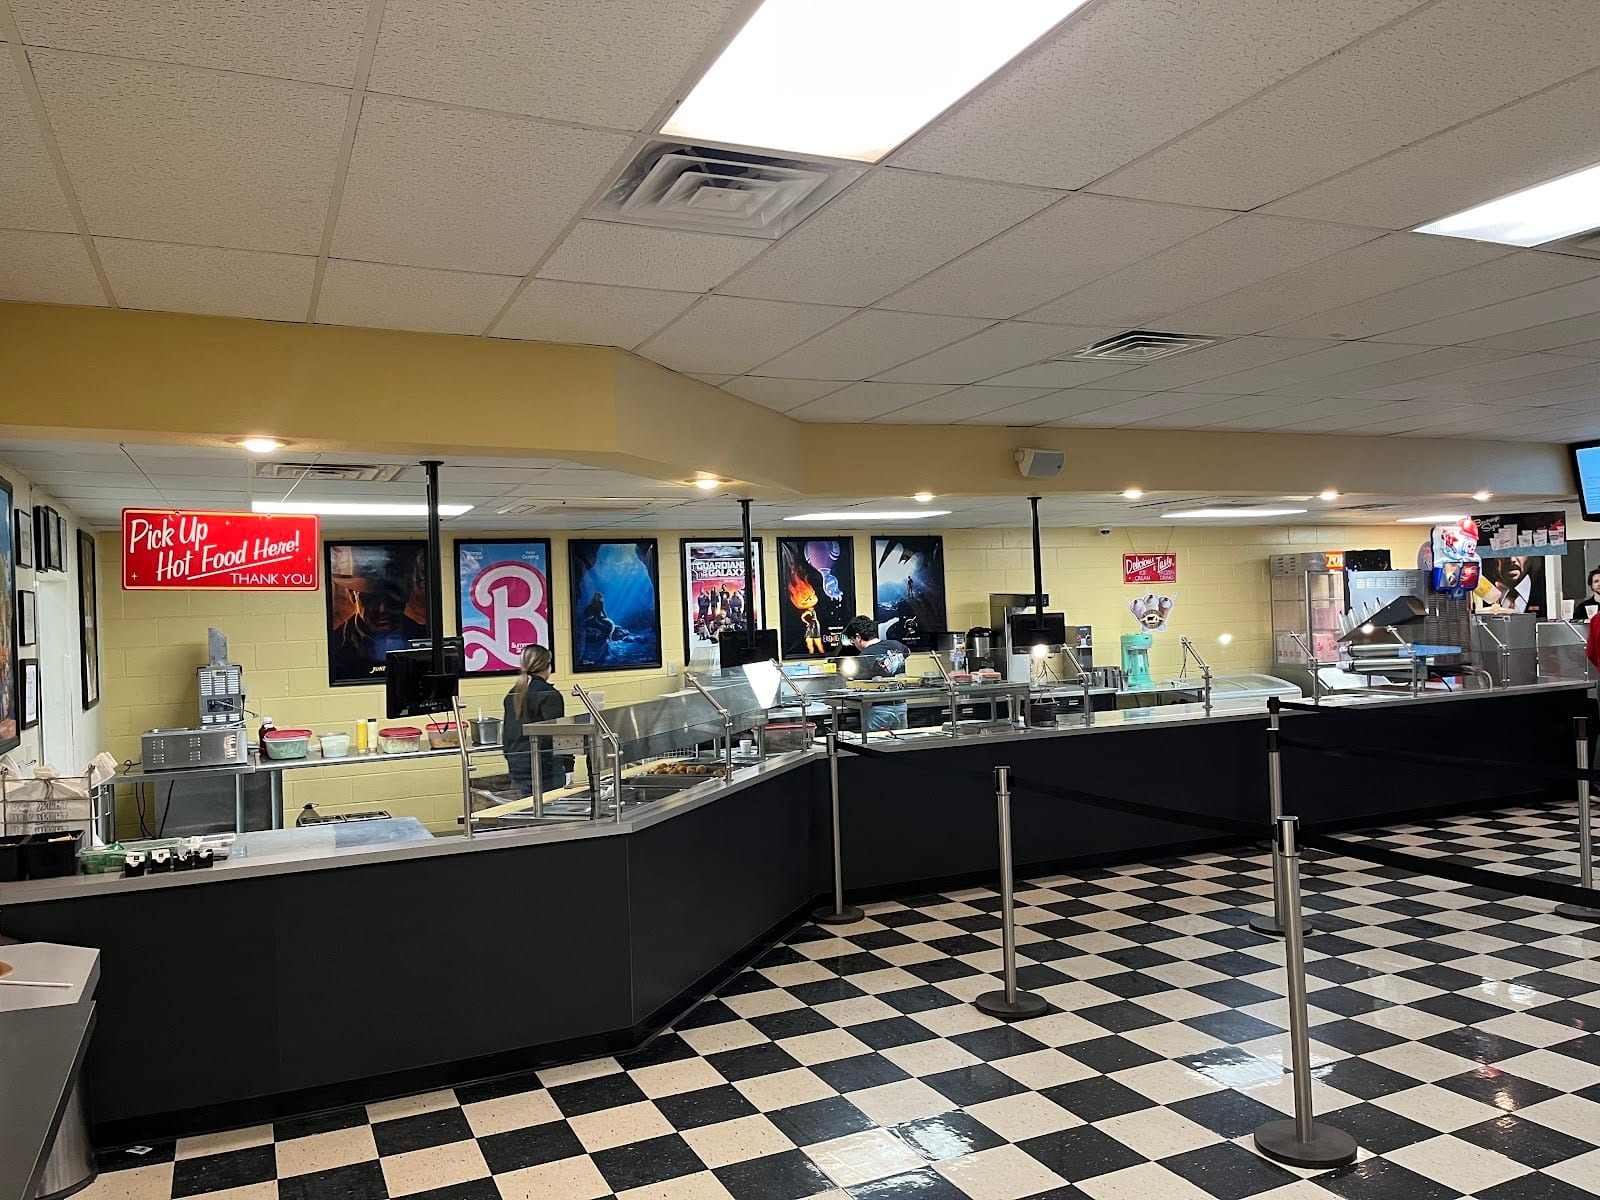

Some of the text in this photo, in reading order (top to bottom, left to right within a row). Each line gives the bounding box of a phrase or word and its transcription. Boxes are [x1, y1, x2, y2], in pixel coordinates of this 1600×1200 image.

[129, 516, 208, 553] Pick Up
[156, 530, 300, 581] Hot Food Here!
[696, 561, 745, 570] GUARDIAN
[230, 573, 313, 585] THANK YOU
